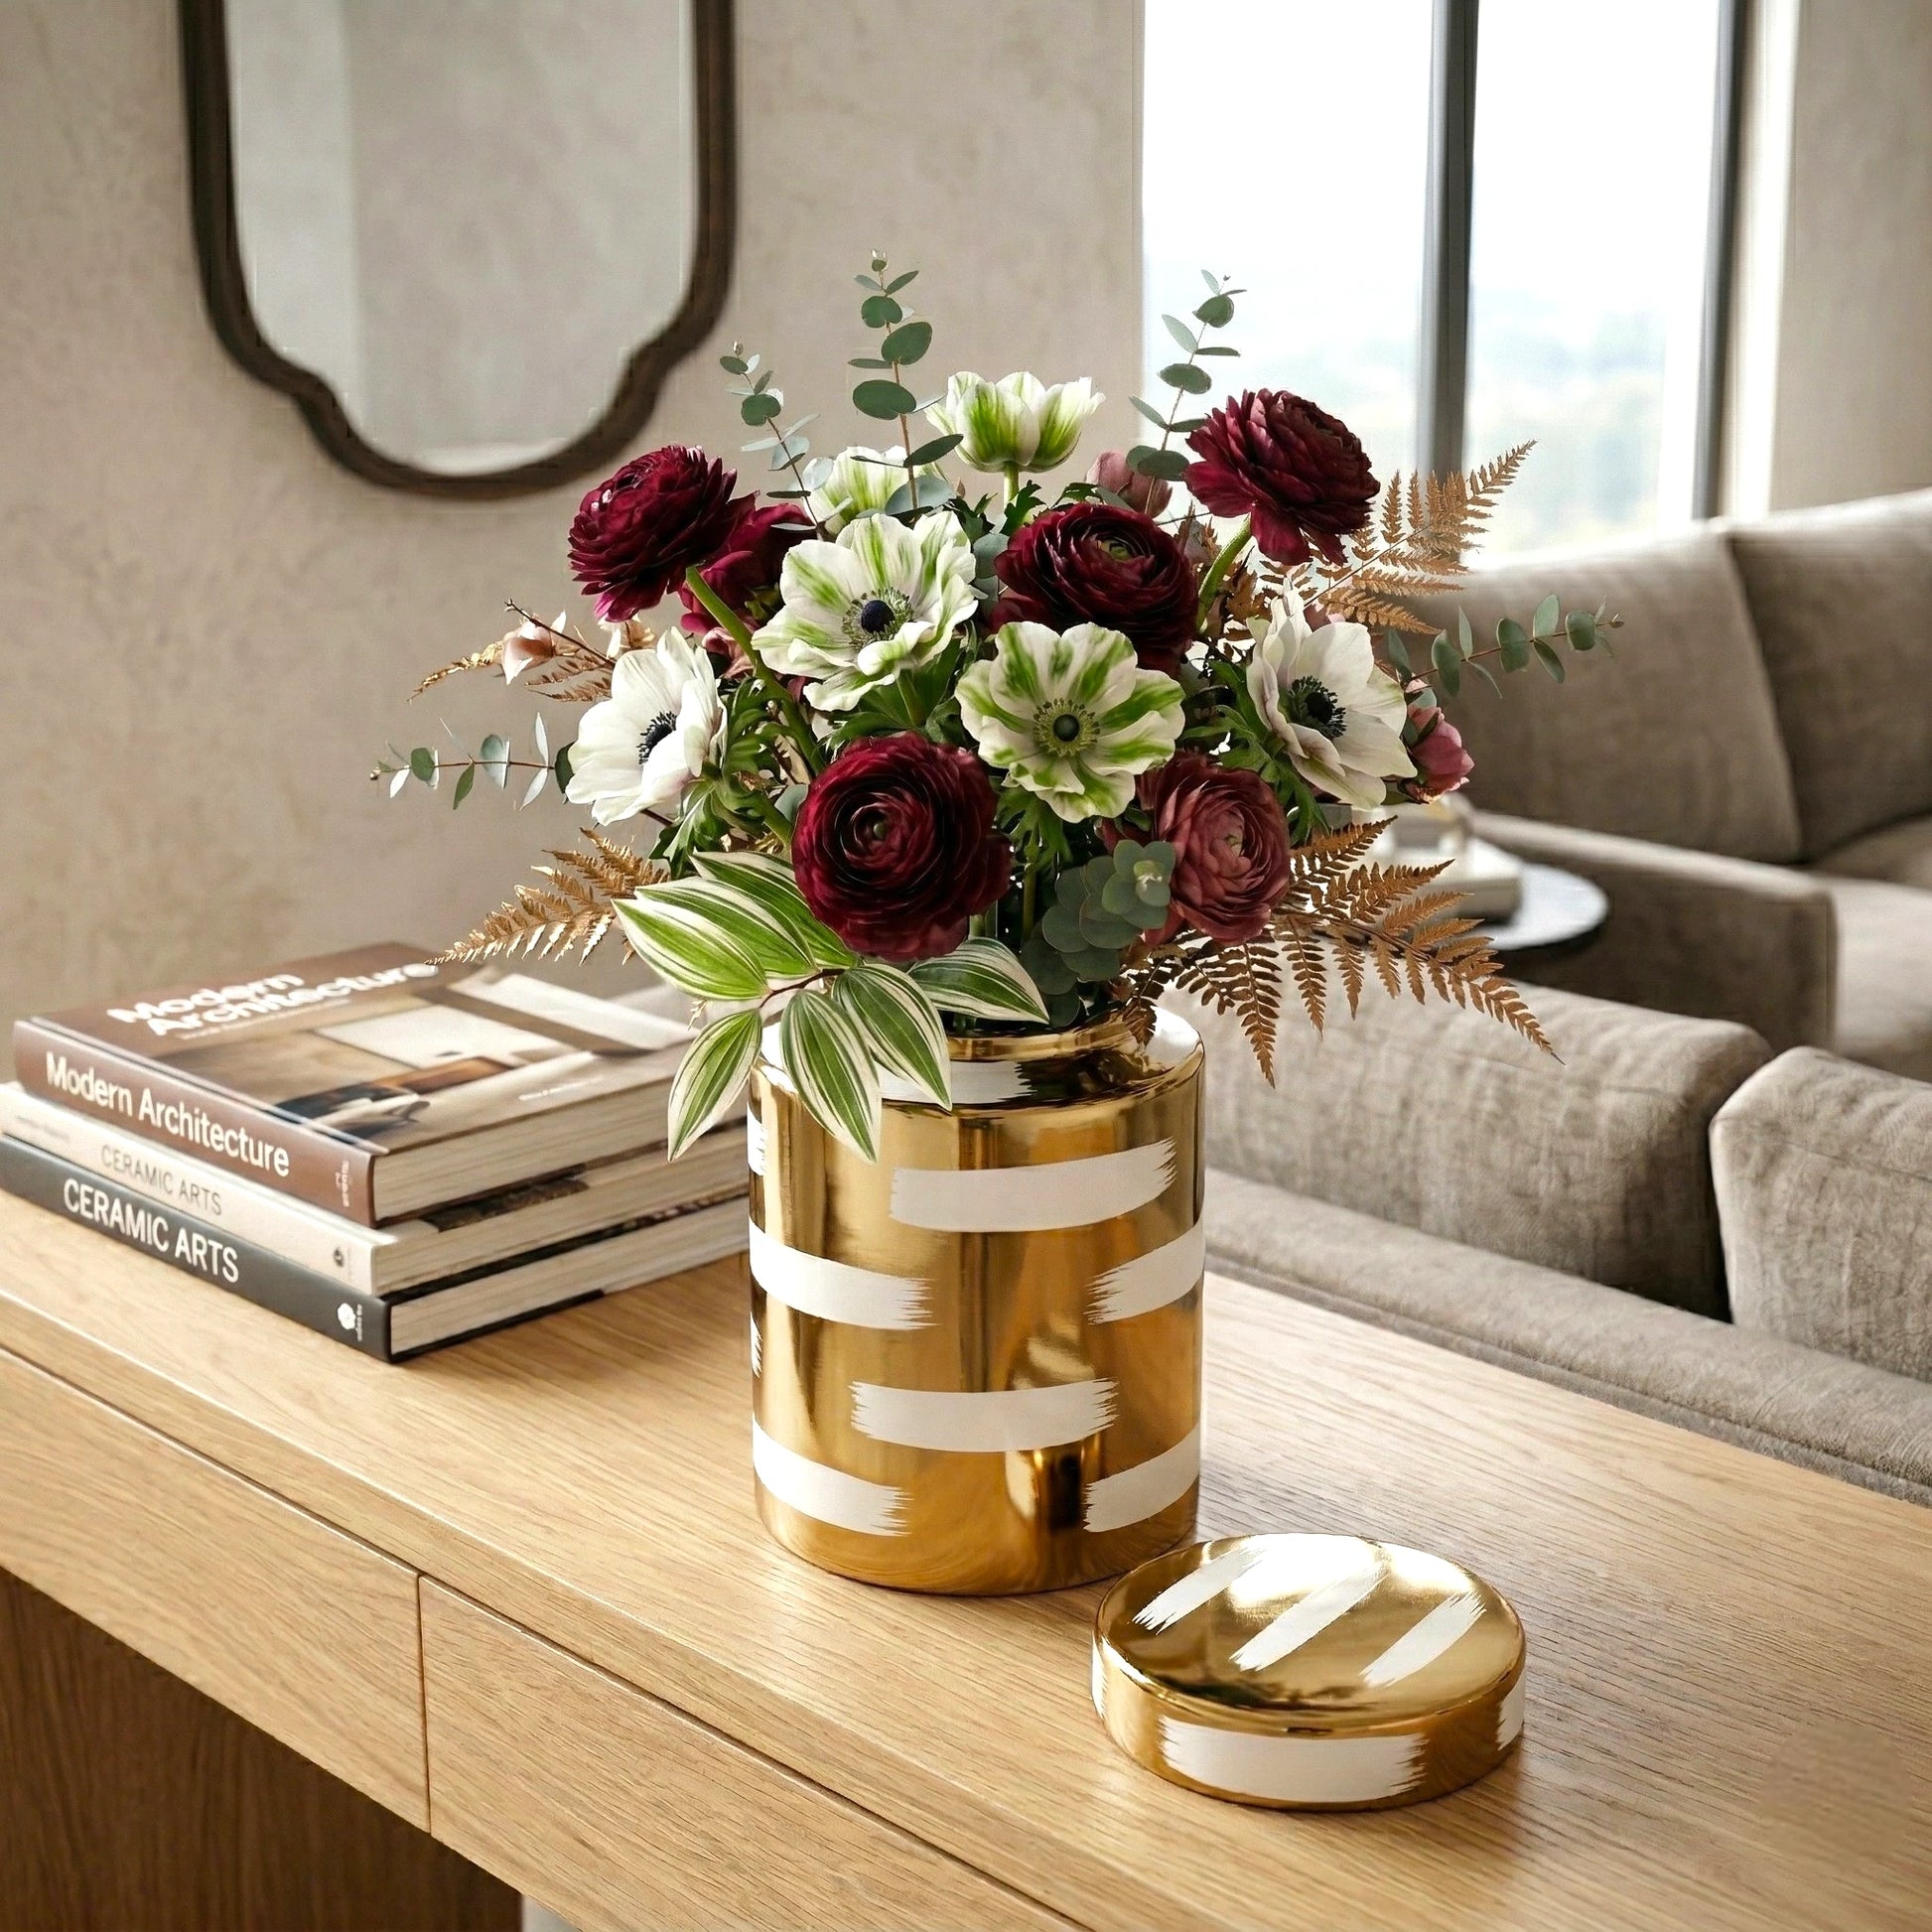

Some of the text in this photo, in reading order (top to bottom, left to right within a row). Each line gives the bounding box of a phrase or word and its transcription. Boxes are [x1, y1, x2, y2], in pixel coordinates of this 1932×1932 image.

[106, 973, 305, 1023] Modern
[147, 962, 439, 1036] Architecture
[46, 1051, 290, 1177] Modern Architecture
[100, 1144, 222, 1216] CERAMIC ARTS
[64, 1177, 239, 1283] CERAMIC ARTS
